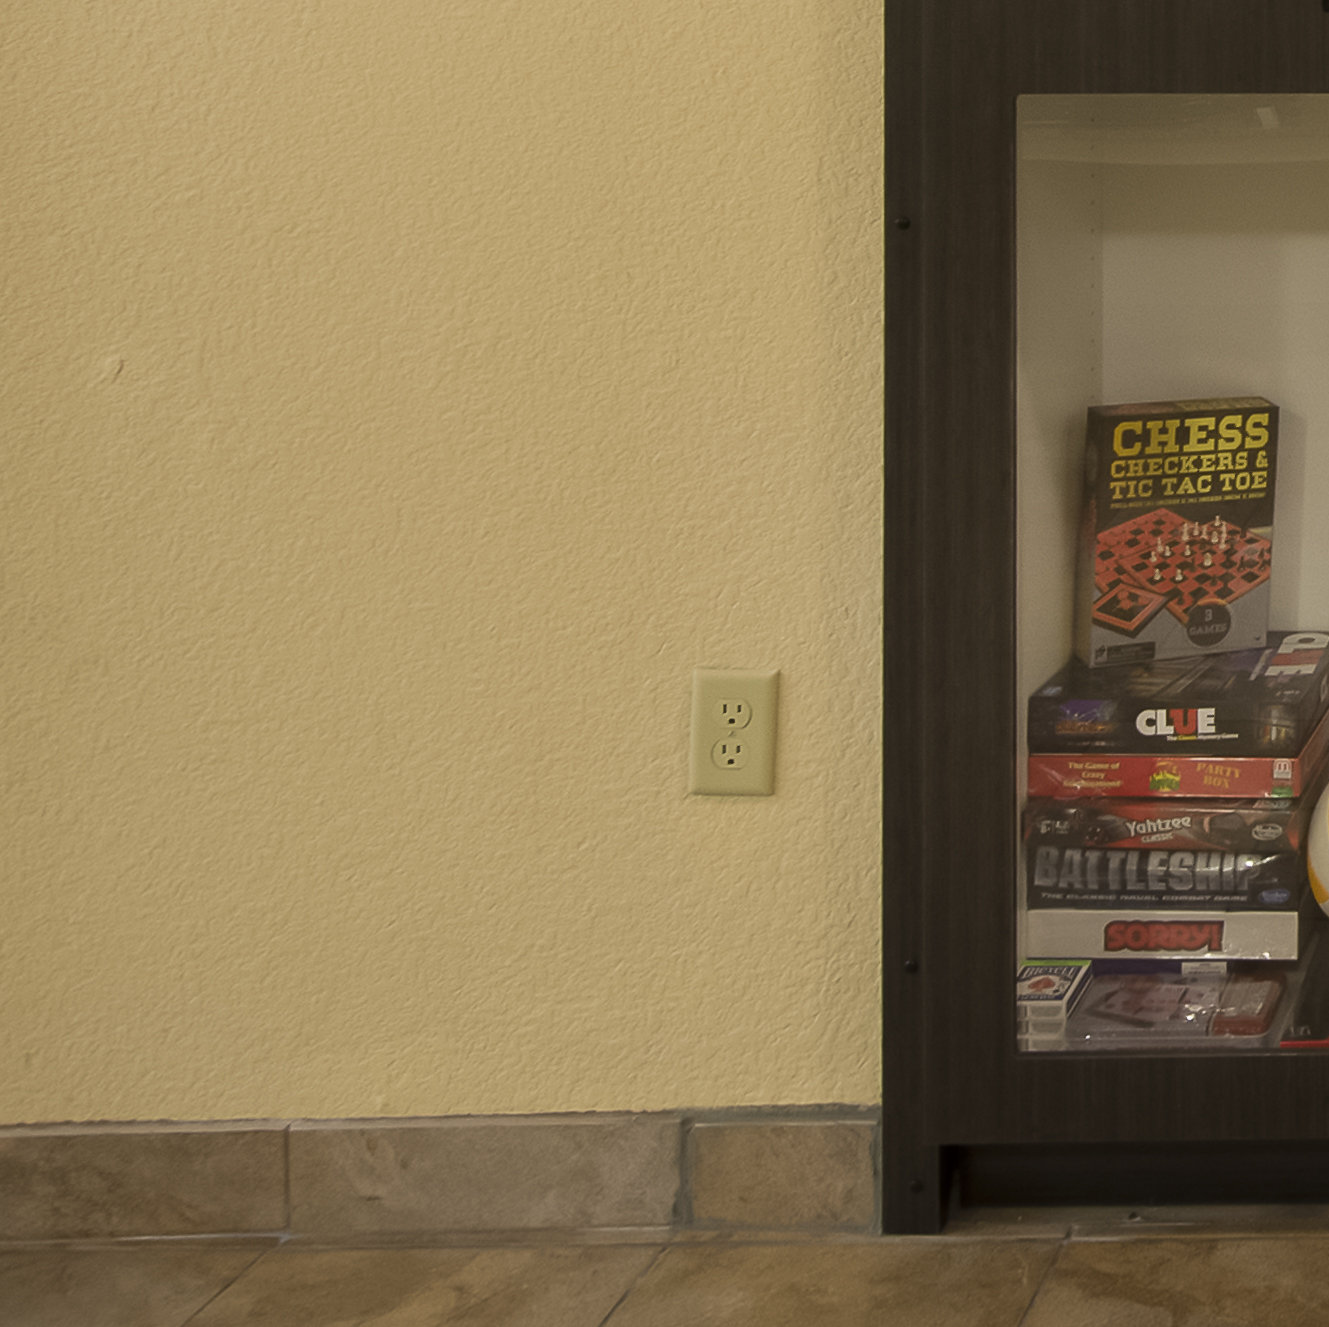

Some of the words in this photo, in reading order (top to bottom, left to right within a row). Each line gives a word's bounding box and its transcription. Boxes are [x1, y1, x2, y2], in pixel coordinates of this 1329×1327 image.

[1113, 413, 1269, 457] CHESS
[1111, 451, 1248, 479] CHECKERS
[1256, 450, 1269, 469] &
[1110, 479, 1153, 500] TIC
[1161, 475, 1212, 496] TAC
[1220, 471, 1268, 492] TOE
[1205, 608, 1213, 622] 3
[1189, 623, 1227, 636] GAMES
[1136, 708, 1216, 736] CLUE
[1196, 762, 1241, 778] PARTY
[1203, 775, 1229, 788] BOX
[1126, 816, 1191, 837] Yahtzee
[1141, 833, 1174, 843] CLASSIC
[1034, 846, 1262, 891] BATTLESHIP
[1105, 920, 1223, 951] SORRY!
